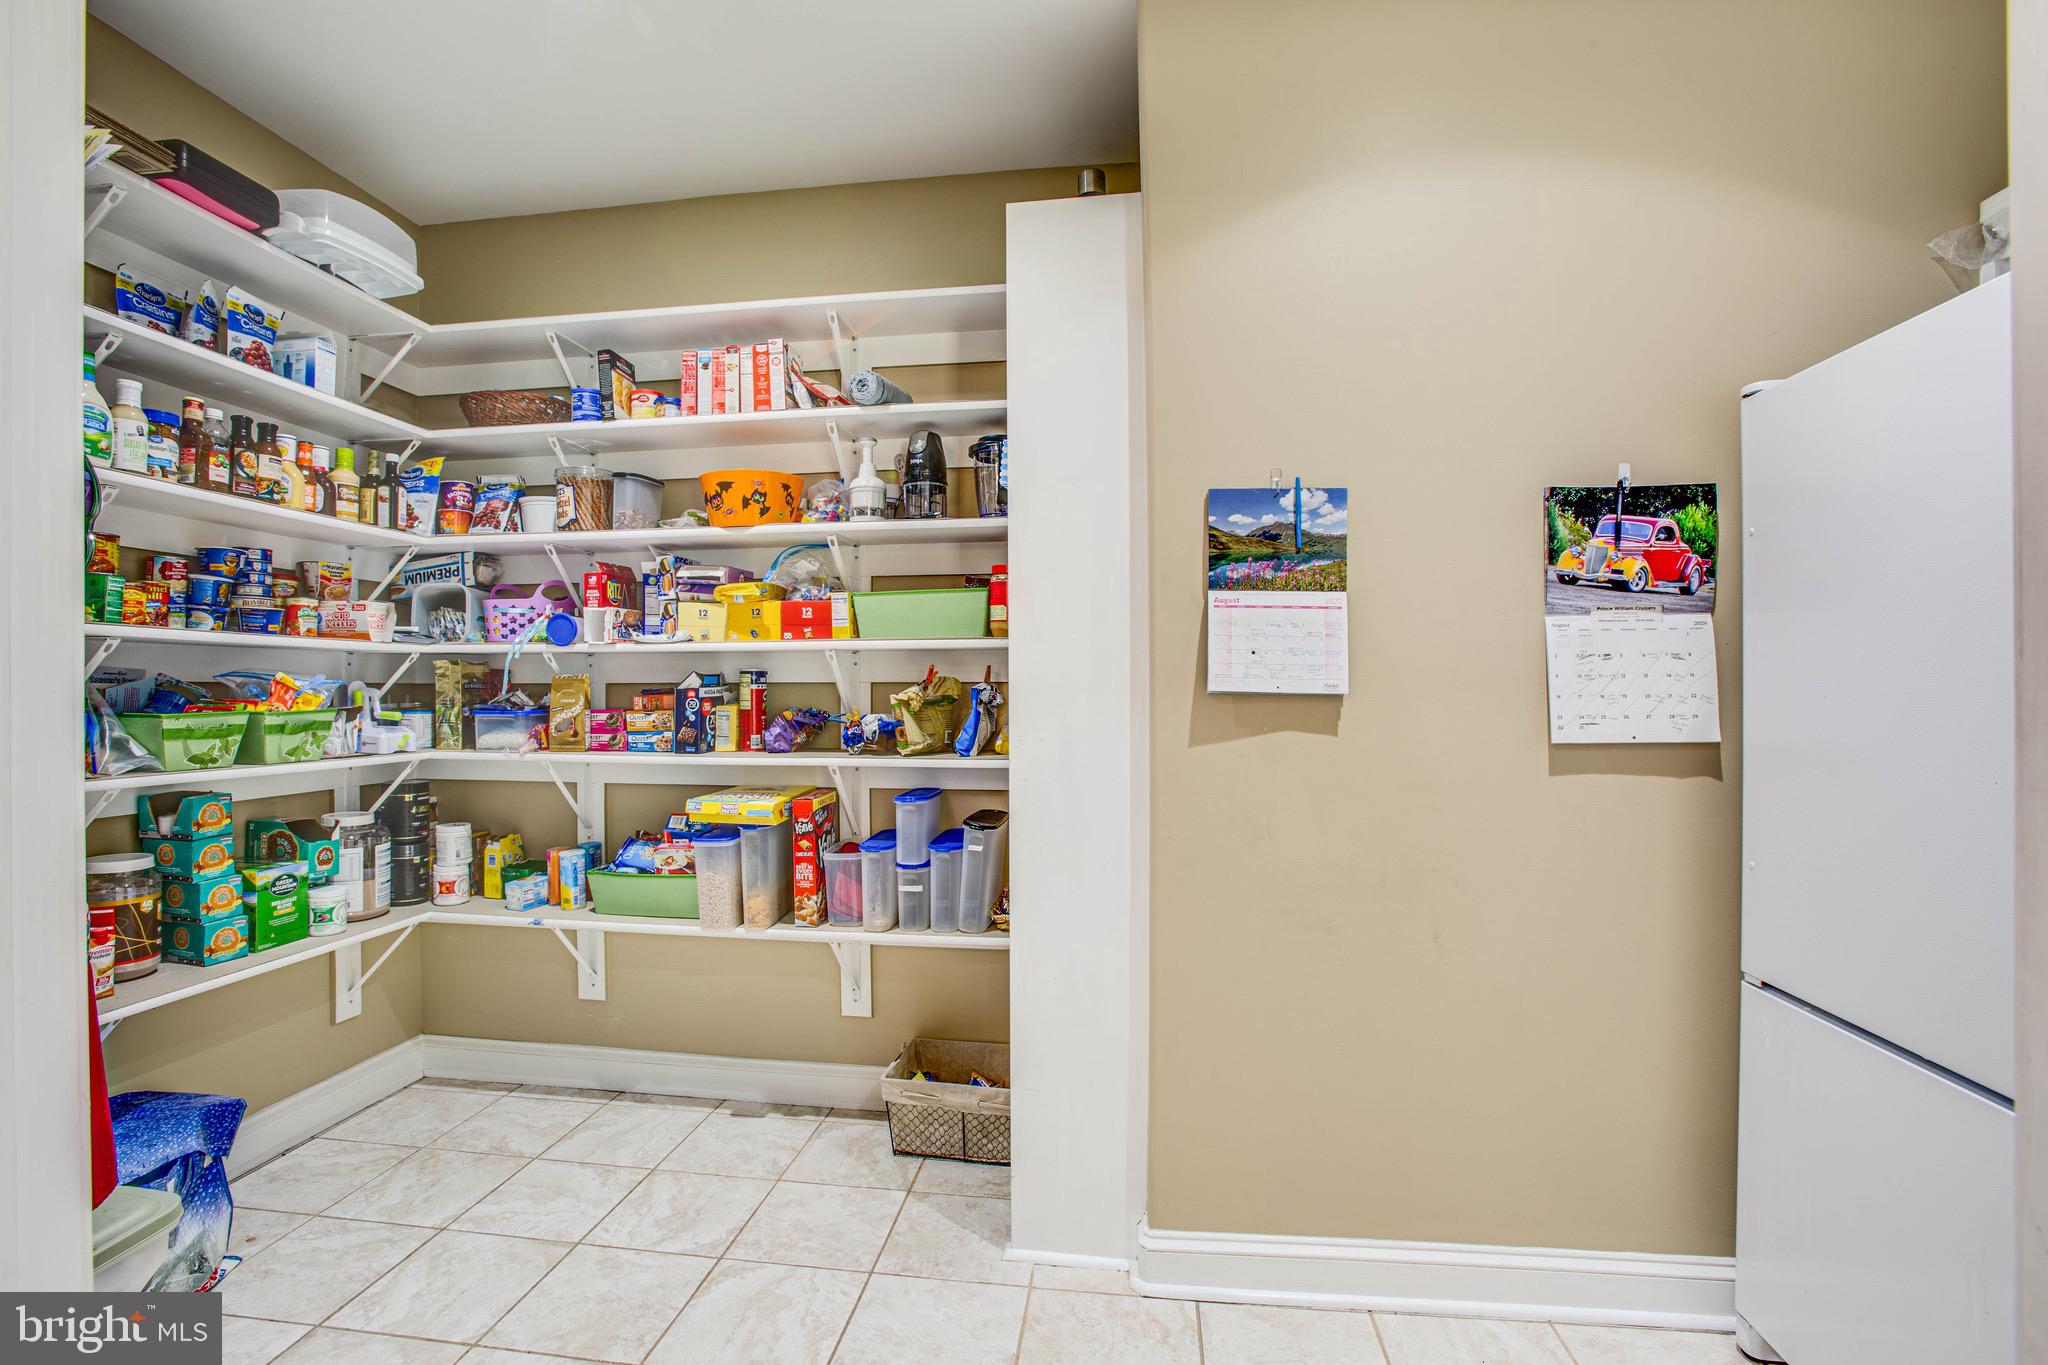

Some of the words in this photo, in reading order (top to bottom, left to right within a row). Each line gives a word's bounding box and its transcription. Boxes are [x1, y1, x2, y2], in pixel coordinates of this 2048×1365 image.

[133, 297, 176, 320] Craisins
[405, 566, 460, 586] PREMIUM
[607, 580, 621, 598] RITZ
[1214, 597, 1240, 605] August
[332, 612, 350, 620] CUP
[698, 609, 708, 617] 12
[751, 608, 761, 616] 12
[802, 607, 812, 615] 12
[325, 618, 357, 629] NOODLES
[795, 821, 814, 834] Krave
[277, 838, 292, 853] DONUT
[271, 881, 298, 892] MOUNTAIN
[275, 878, 293, 886] GREEN
